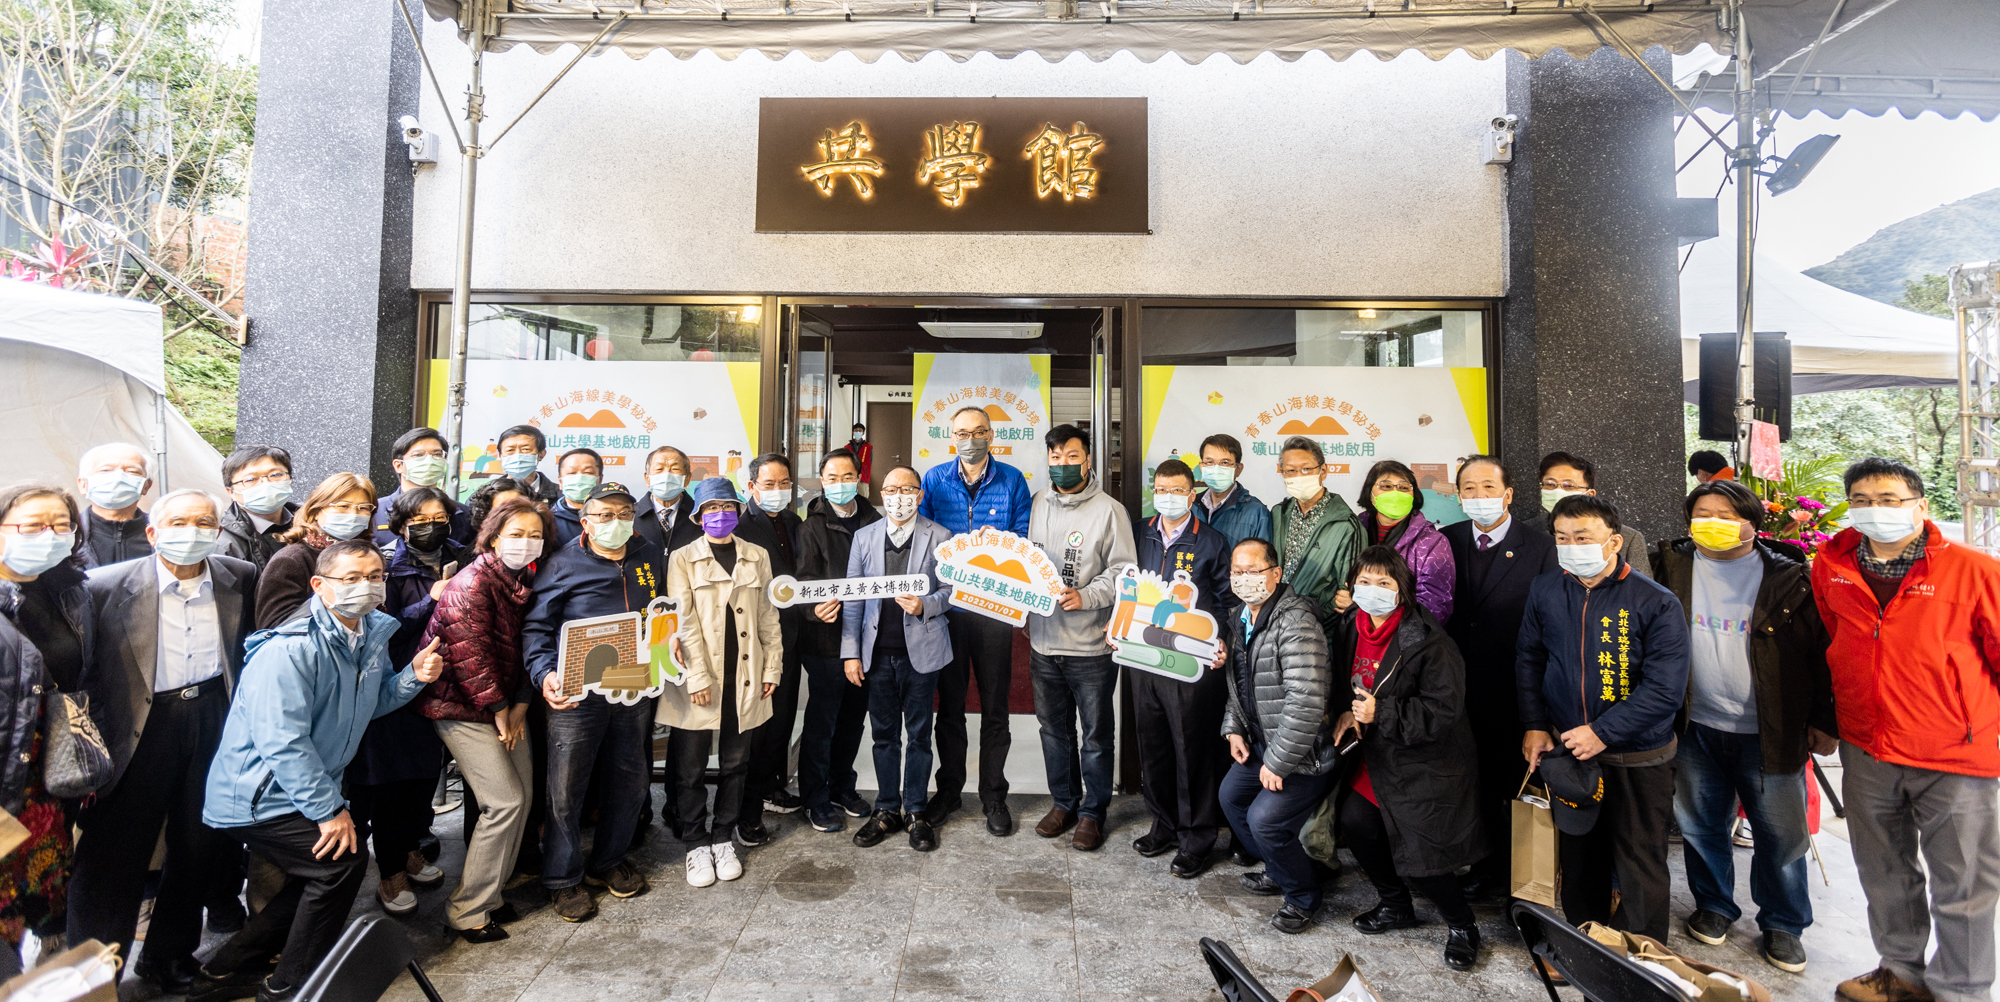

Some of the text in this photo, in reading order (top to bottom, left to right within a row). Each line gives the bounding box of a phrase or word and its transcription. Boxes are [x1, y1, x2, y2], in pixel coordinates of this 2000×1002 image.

[800, 119, 1105, 206] 共學館
[527, 388, 658, 434] 青春山海線美學秘境
[922, 385, 1041, 427] 青春山海線美學秘境
[1244, 395, 1382, 441] 青春山海線美學秘境
[543, 434, 651, 449] 山共學基地啟用
[928, 426, 1034, 440] 礦山地啟用
[1252, 441, 1375, 457] 礦山基地啟用
[938, 529, 1062, 597] 青春山海線美學秘境
[1184, 552, 1195, 578] 新北
[799, 579, 925, 599] 新北市立黃金博物館
[939, 562, 1053, 612] 礦山共學基地啟用
[962, 593, 1016, 617] 2022/01/07
[1597, 616, 1616, 702] 會長 林富萬
